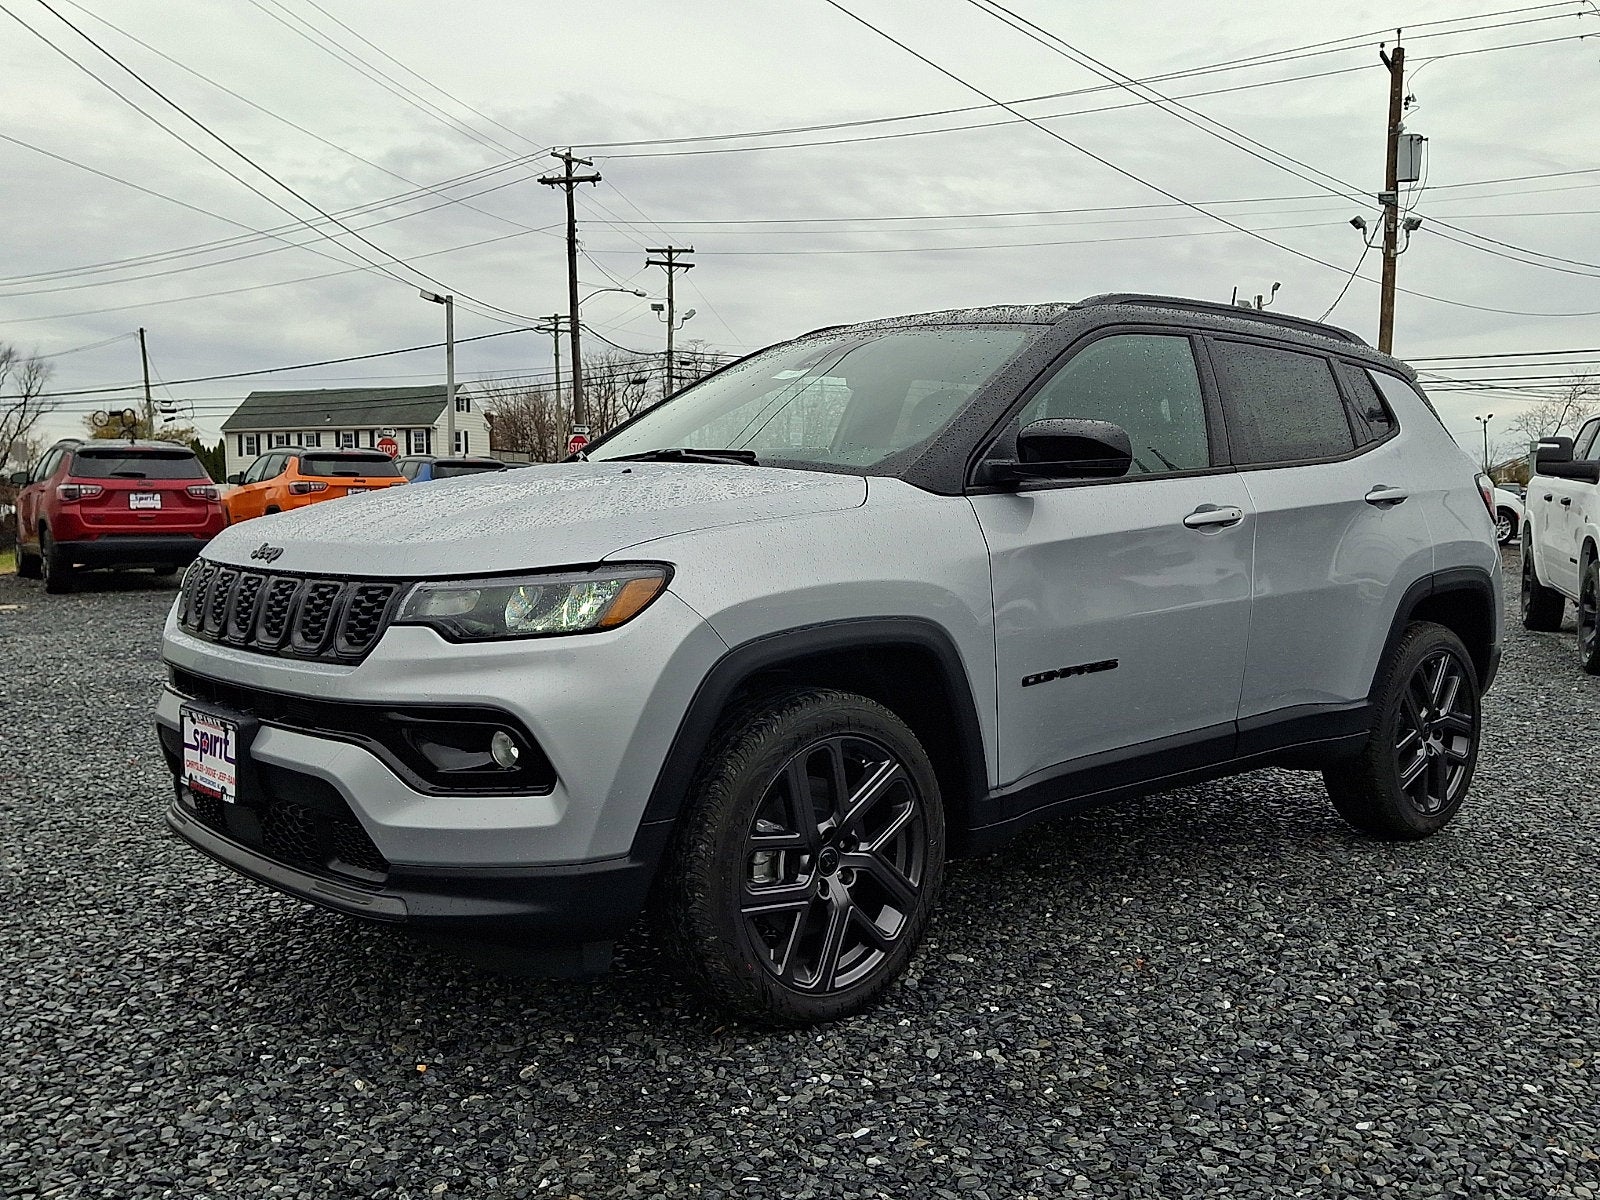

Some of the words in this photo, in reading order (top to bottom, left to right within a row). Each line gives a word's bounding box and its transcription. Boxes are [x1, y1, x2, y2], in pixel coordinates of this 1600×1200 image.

[378, 444, 397, 454] STOP
[250, 542, 284, 564] Jeep
[1021, 658, 1119, 688] COMPASS
